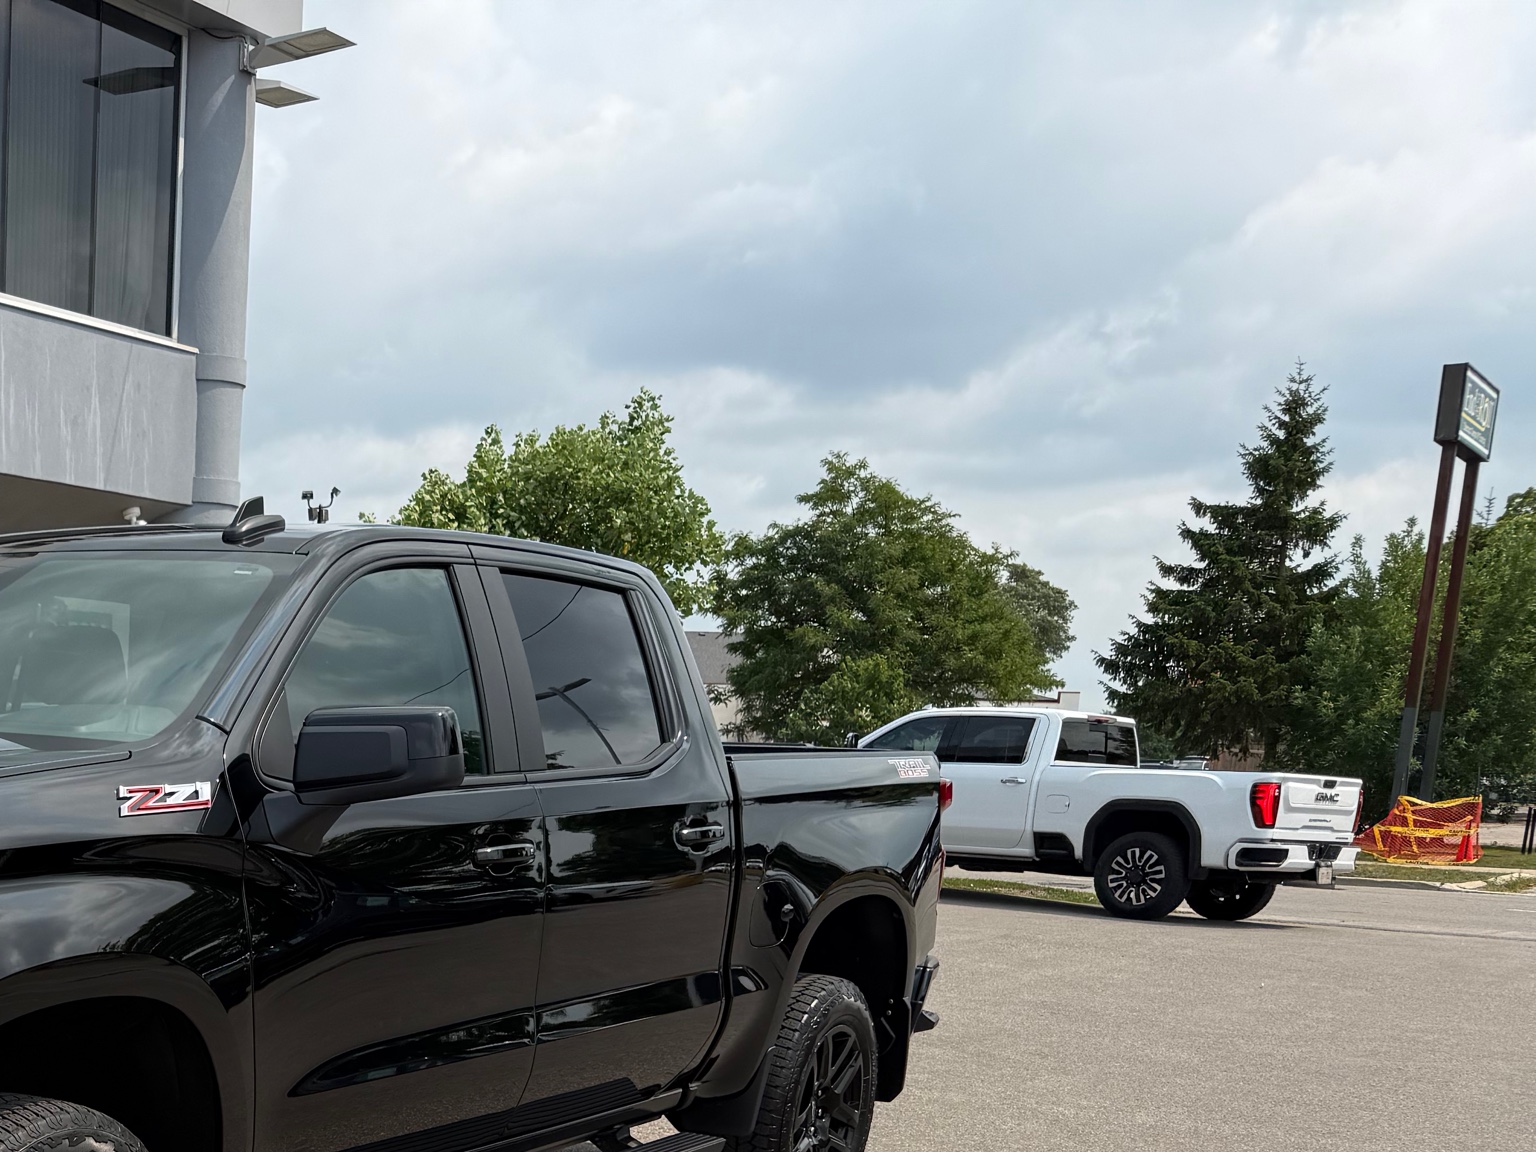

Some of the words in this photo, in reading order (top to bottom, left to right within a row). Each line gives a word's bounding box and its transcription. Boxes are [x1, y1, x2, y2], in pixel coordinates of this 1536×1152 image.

[888, 758, 931, 770] TRAIL
[898, 769, 929, 778] BOSS
[118, 782, 212, 817] Z71
[1315, 792, 1340, 803] GMC
